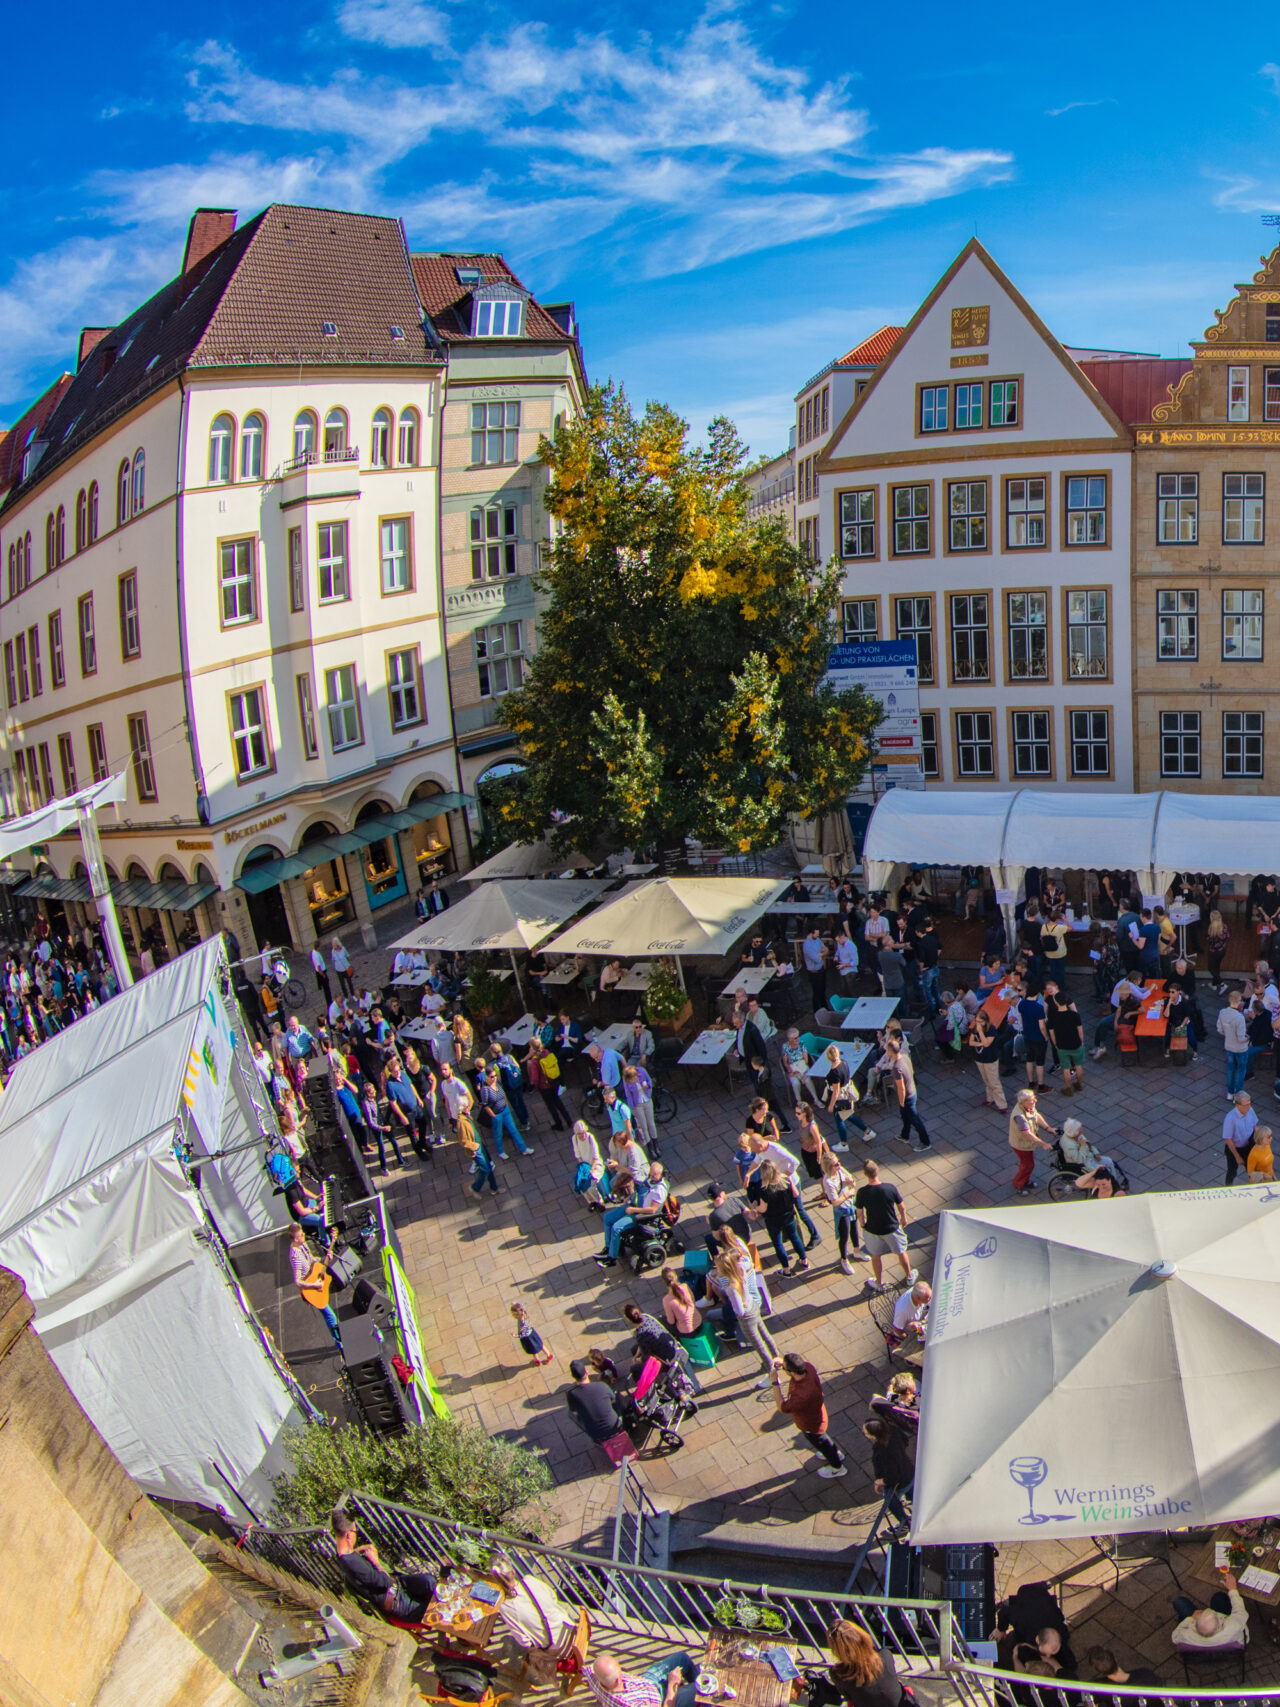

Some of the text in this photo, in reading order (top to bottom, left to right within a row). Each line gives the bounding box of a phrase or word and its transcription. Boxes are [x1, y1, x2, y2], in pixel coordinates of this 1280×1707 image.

[840, 657, 857, 665] UND
[857, 653, 914, 664] PRAXISFLÄCHEN
[863, 646, 880, 654] VON
[223, 812, 288, 845] BÖCKELMANN
[948, 1264, 971, 1317] Wernings
[934, 1280, 954, 1337] Weinstube
[1054, 1483, 1156, 1506] Wernings
[1081, 1496, 1193, 1523] Weinstube
